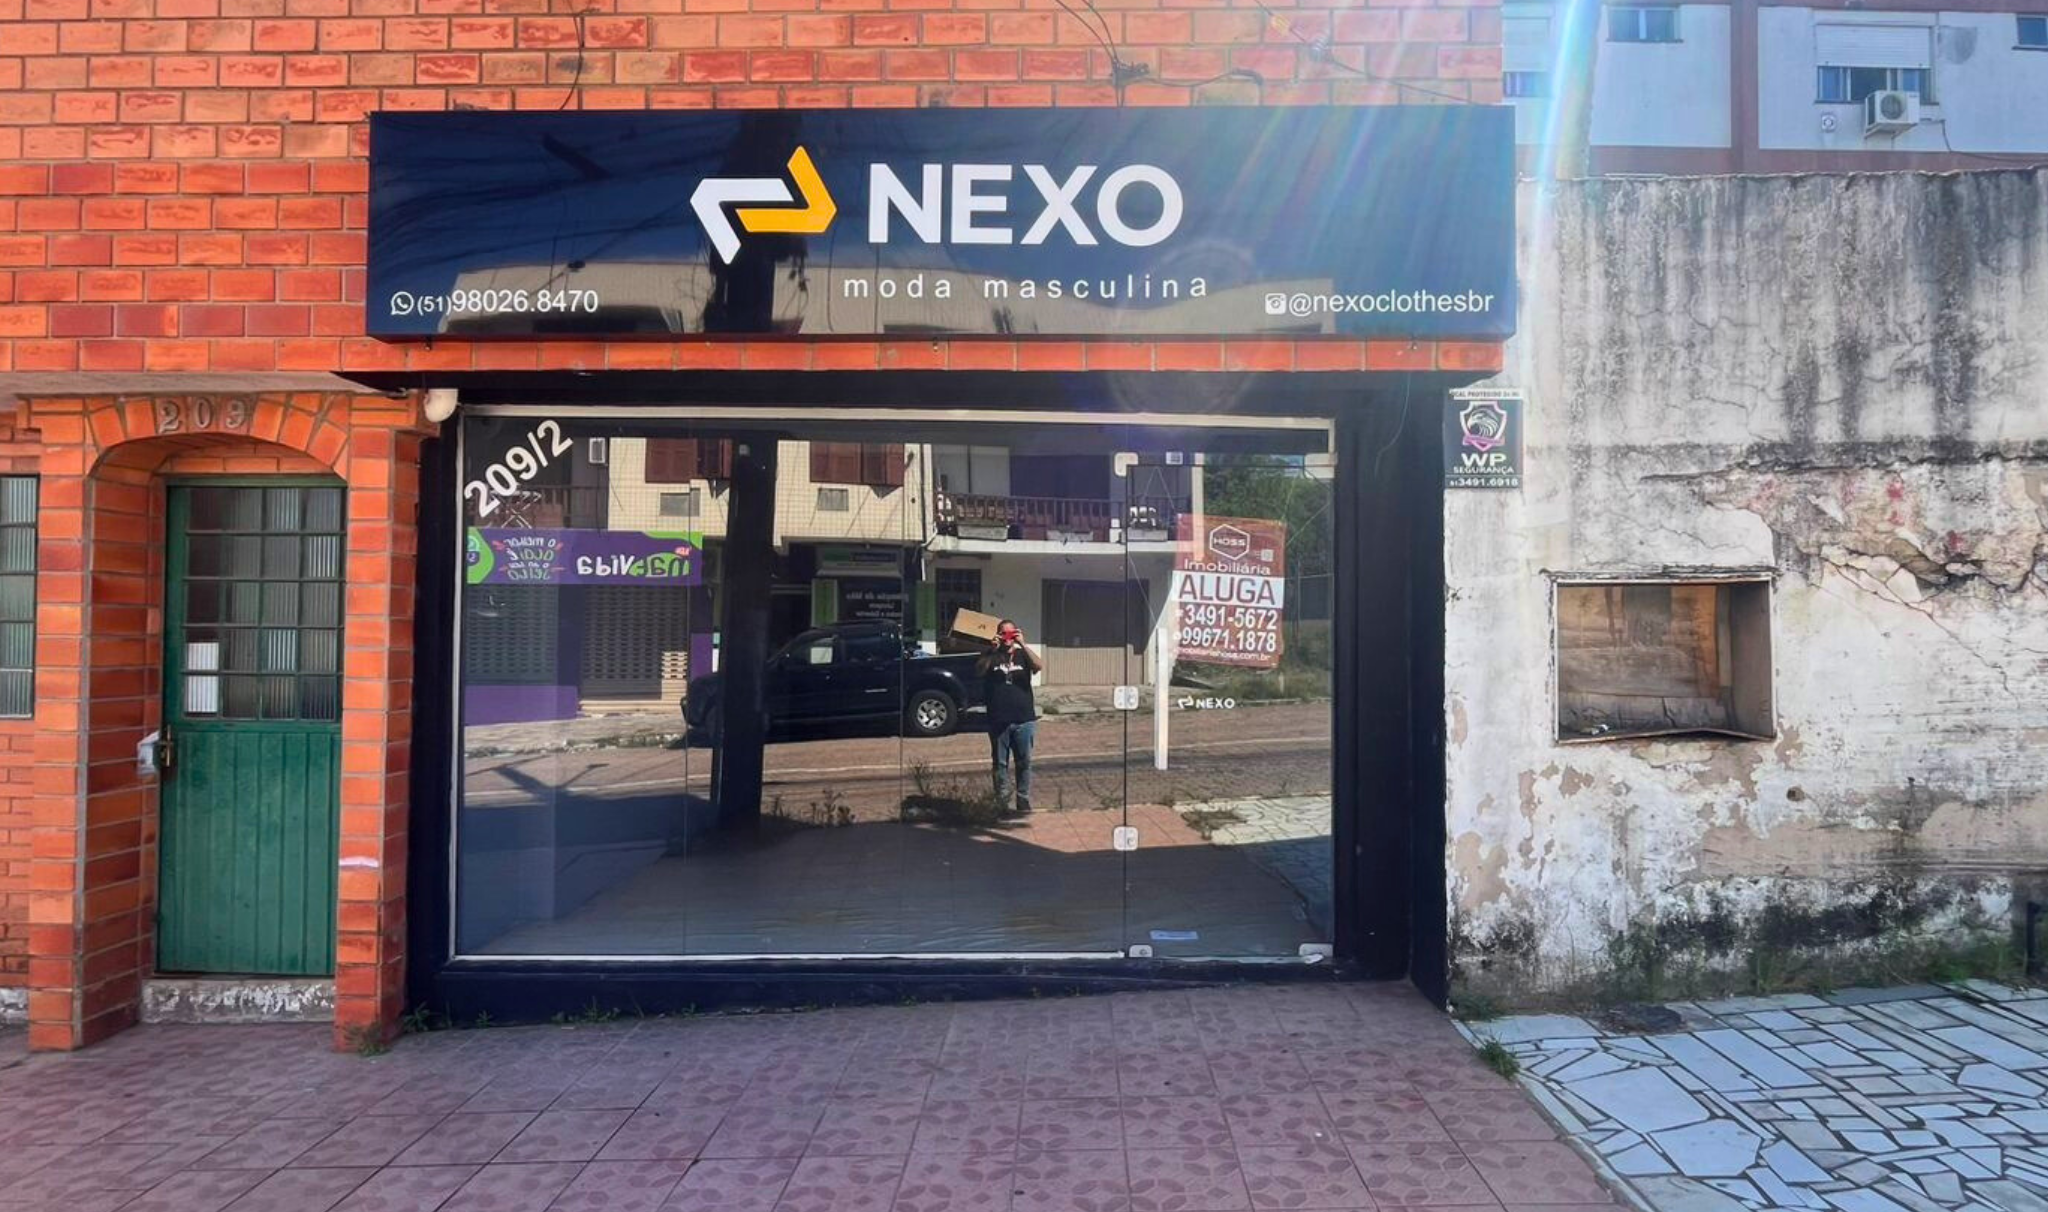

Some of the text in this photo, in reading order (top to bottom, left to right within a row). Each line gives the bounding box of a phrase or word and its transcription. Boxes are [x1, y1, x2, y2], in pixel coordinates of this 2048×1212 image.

[868, 162, 1184, 247] NEXO
[843, 273, 1208, 299] moda masculina
[1288, 289, 1494, 315] @nexoclothesbr
[158, 398, 246, 434] 209
[463, 418, 574, 518] 209/2
[1453, 465, 1515, 475] SEGURANÇA
[1460, 452, 1507, 467] WP
[1213, 537, 1247, 546] HOSS
[1183, 558, 1272, 576] Imobiliária
[1178, 573, 1276, 606] ALUGA
[1184, 604, 1278, 631] 3491-5672
[1182, 626, 1277, 653] 99671.1878
[1195, 697, 1236, 709] NEXO
